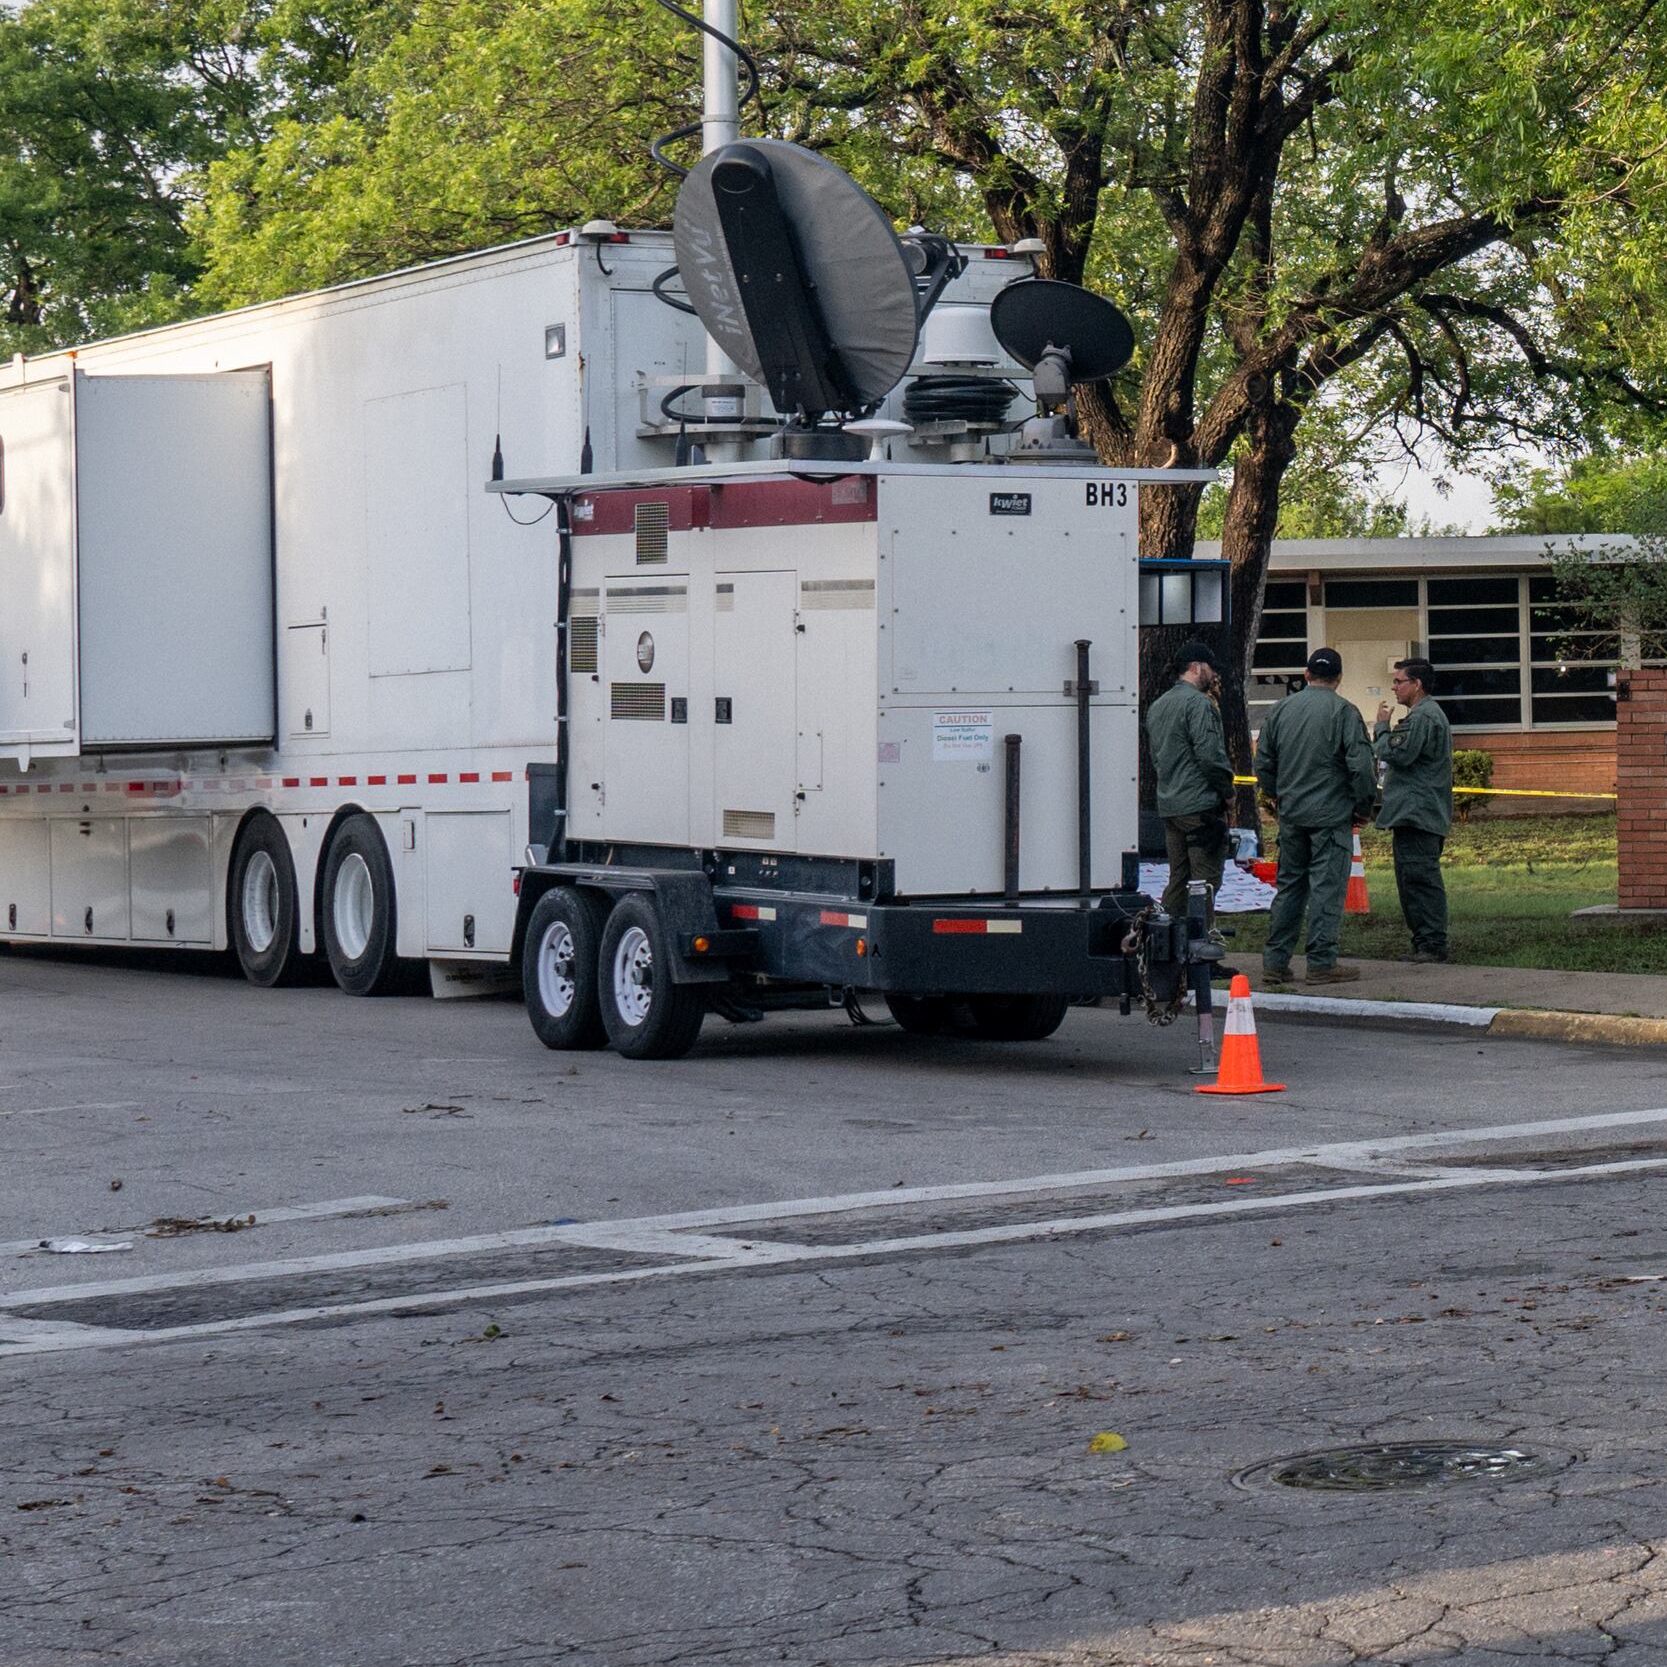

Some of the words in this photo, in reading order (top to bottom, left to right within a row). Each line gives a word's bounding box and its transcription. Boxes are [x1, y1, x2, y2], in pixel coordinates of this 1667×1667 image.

[1085, 482, 1127, 507] BH3
[993, 494, 1028, 509] kwiet
[939, 715, 988, 724] CAUTION
[974, 734, 989, 742] Only
